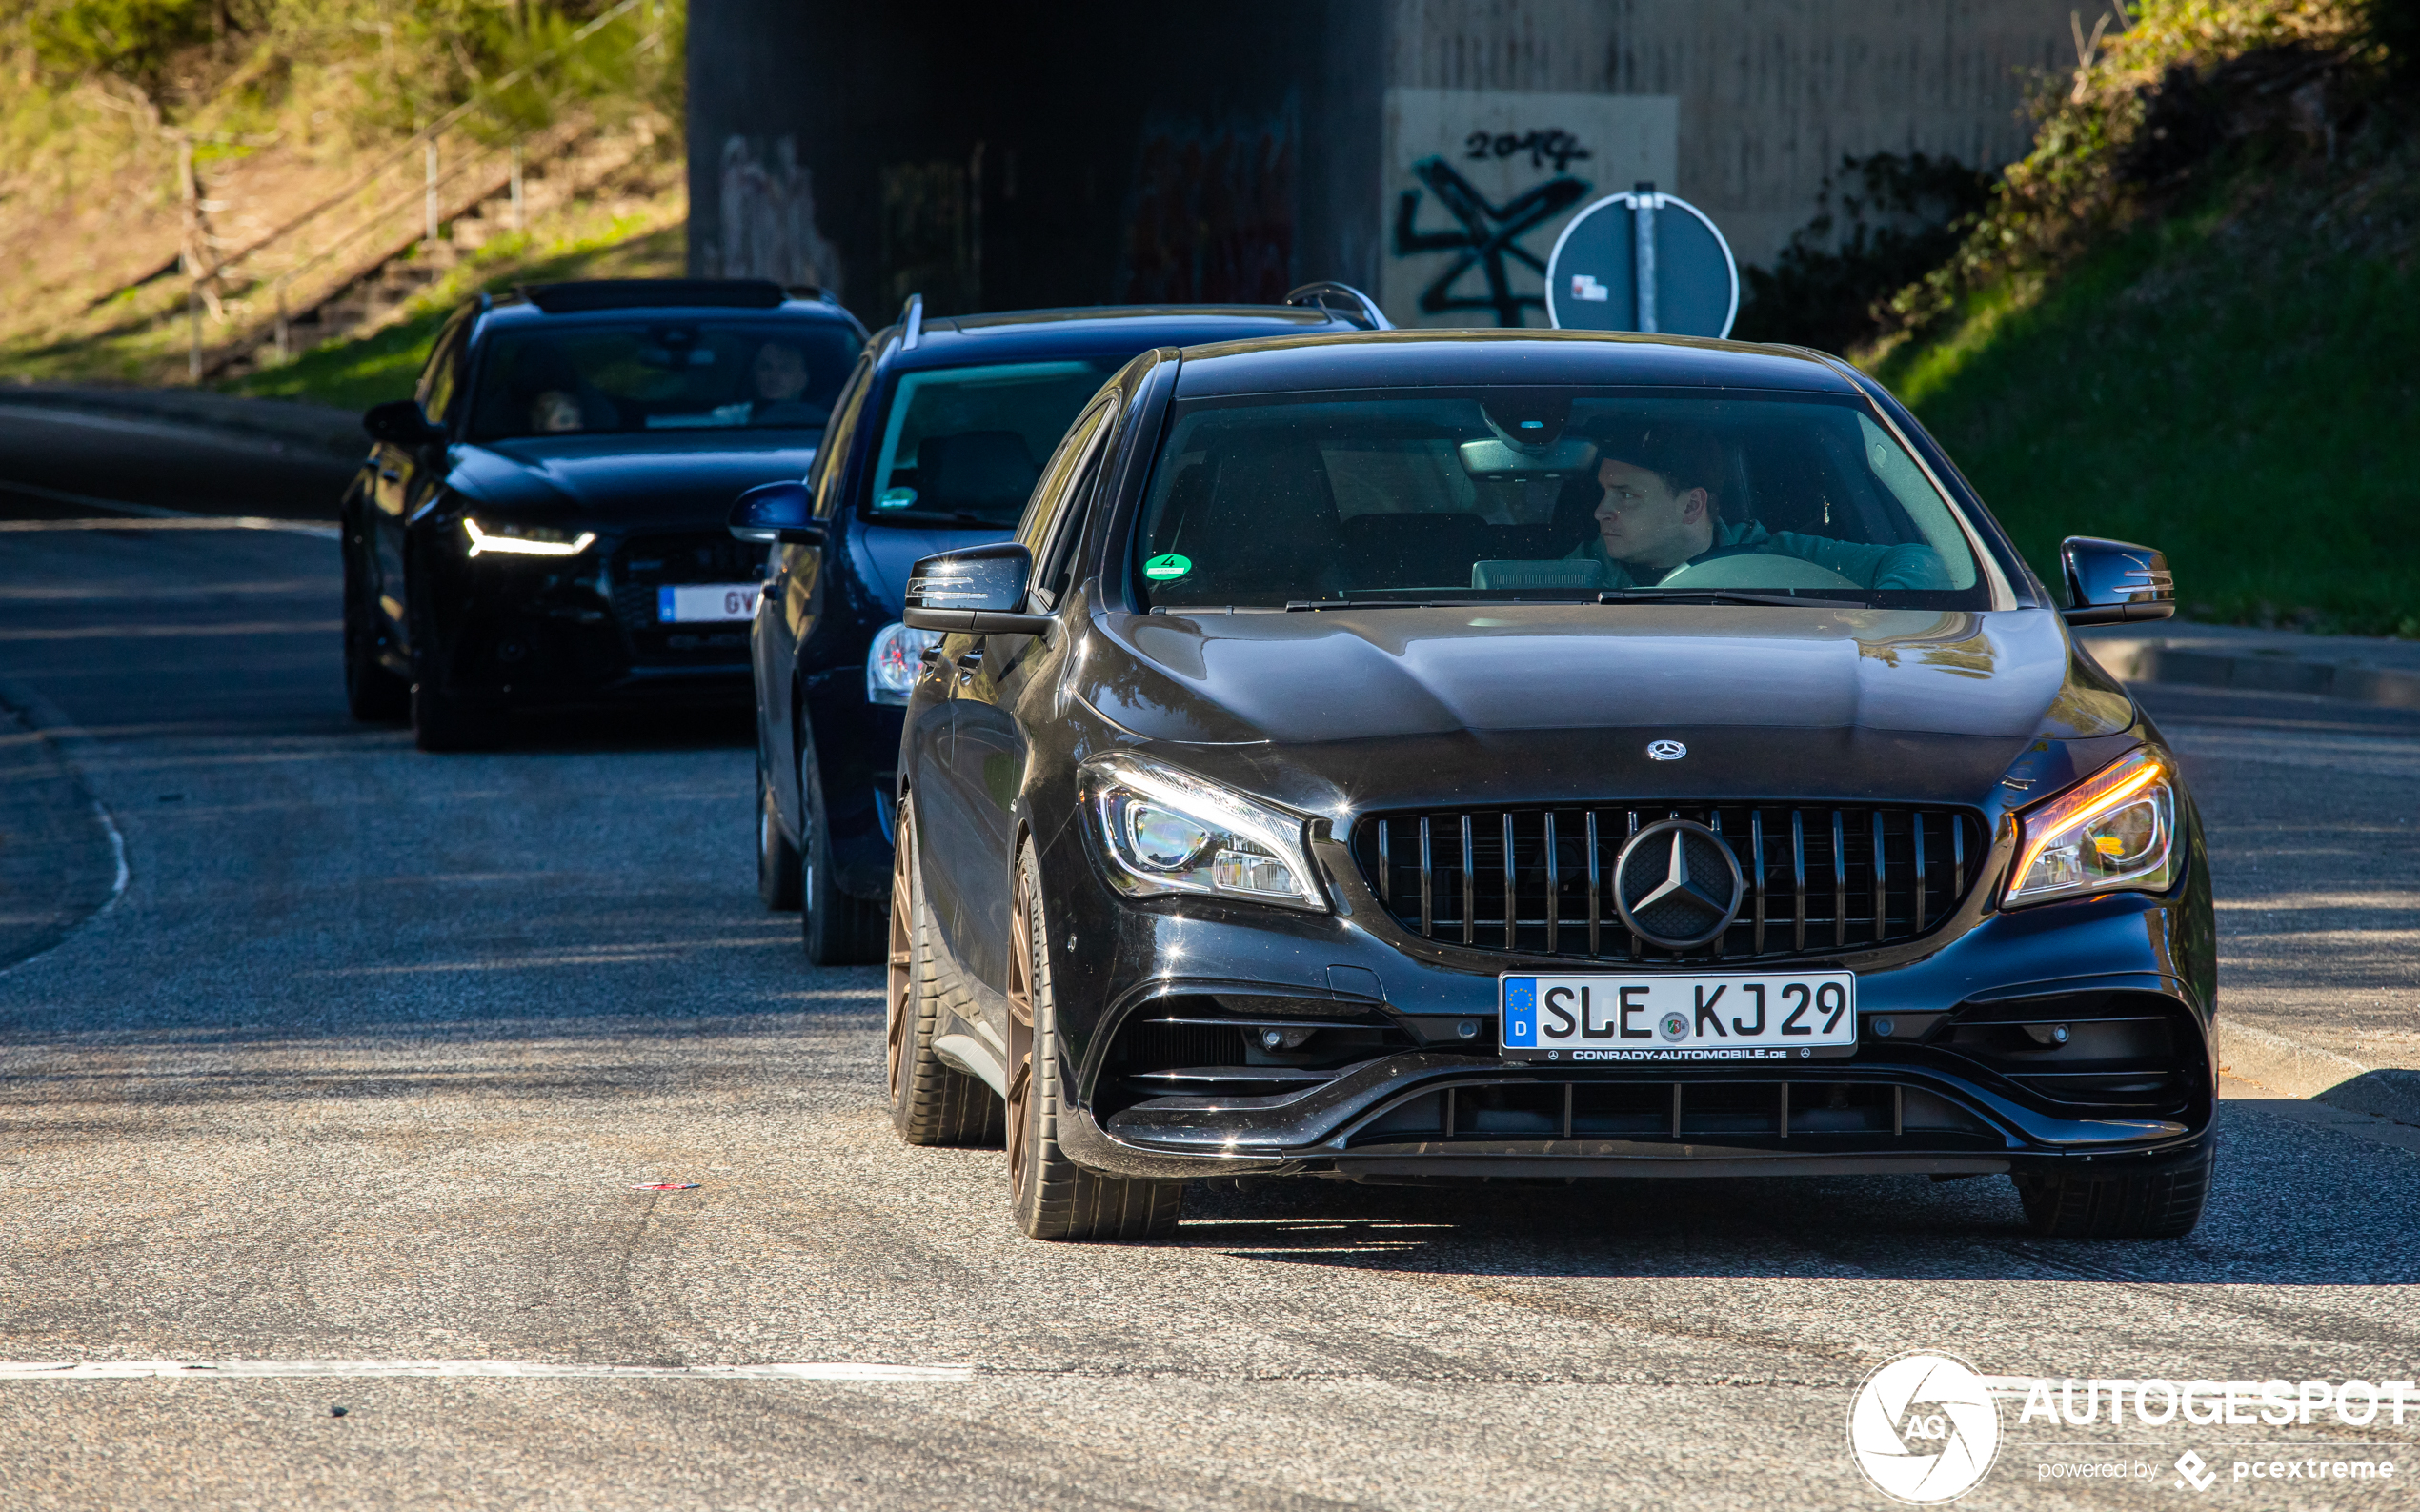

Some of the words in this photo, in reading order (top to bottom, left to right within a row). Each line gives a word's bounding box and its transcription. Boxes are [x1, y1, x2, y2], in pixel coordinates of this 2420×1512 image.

[1160, 555, 1175, 567] 4
[1032, 897, 1040, 989] MICHELIN
[1542, 985, 1653, 1038] SLE
[1695, 983, 1765, 1037] KJ
[1781, 981, 1846, 1035] 29
[1515, 1021, 1527, 1036] D
[1572, 1049, 1787, 1060] CONRADY-AUTOMOBILE.DE
